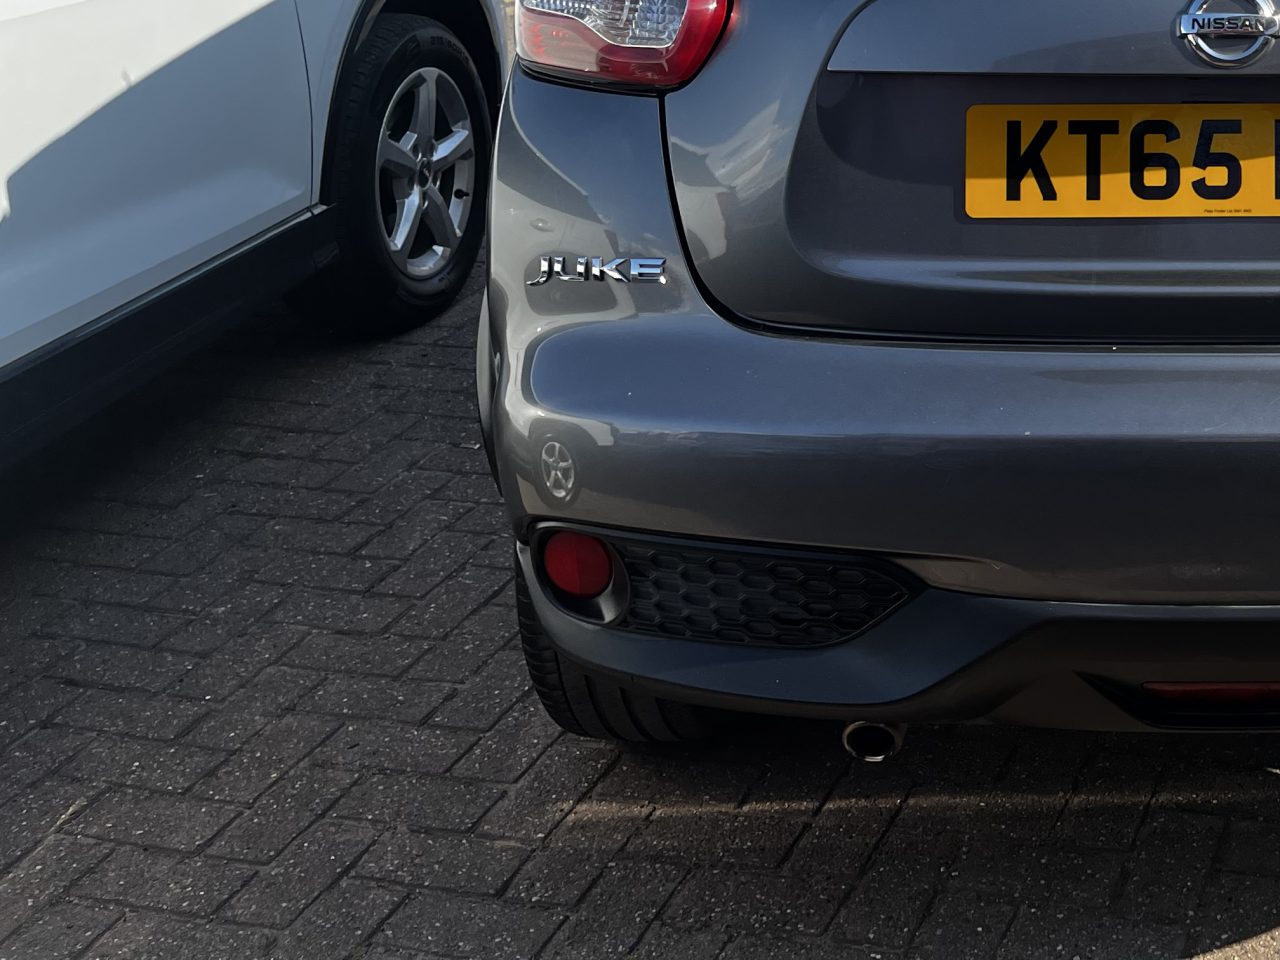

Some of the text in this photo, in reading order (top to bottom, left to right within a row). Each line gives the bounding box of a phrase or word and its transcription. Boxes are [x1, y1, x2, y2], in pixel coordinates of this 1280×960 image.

[1191, 17, 1264, 30] NISSAN
[1005, 119, 1243, 201] KT65
[526, 256, 667, 286] JUKE
